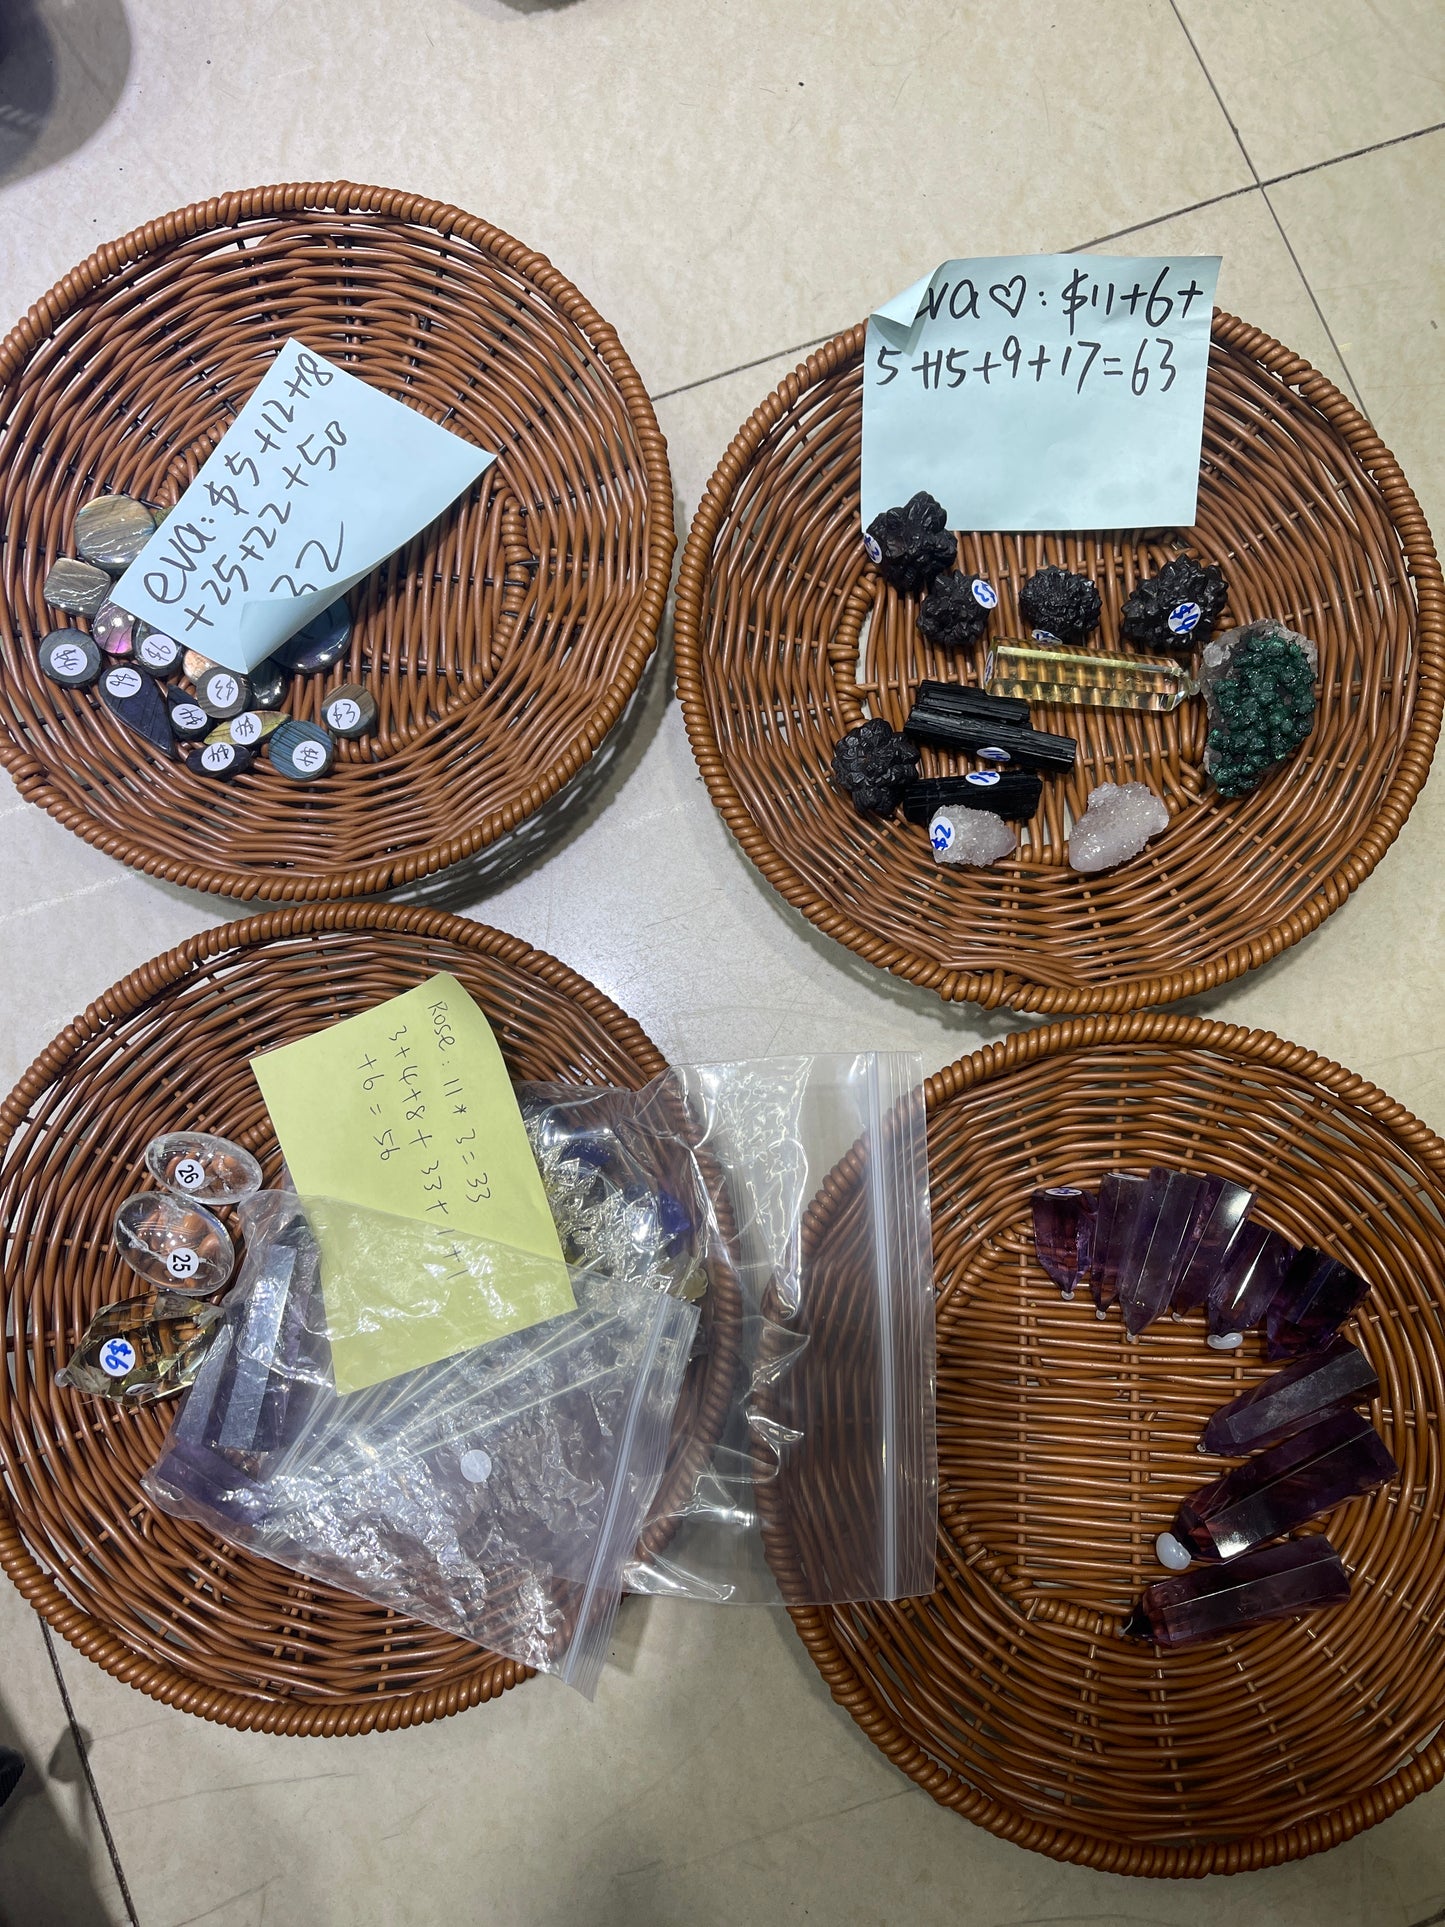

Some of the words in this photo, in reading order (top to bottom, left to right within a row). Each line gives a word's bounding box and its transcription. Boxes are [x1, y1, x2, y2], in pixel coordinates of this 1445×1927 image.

[1170, 602, 1199, 633] $4
[333, 702, 356, 728] $3
[178, 1164, 200, 1185] 26
[172, 1254, 192, 1273] 25
[106, 1340, 132, 1370] $6
